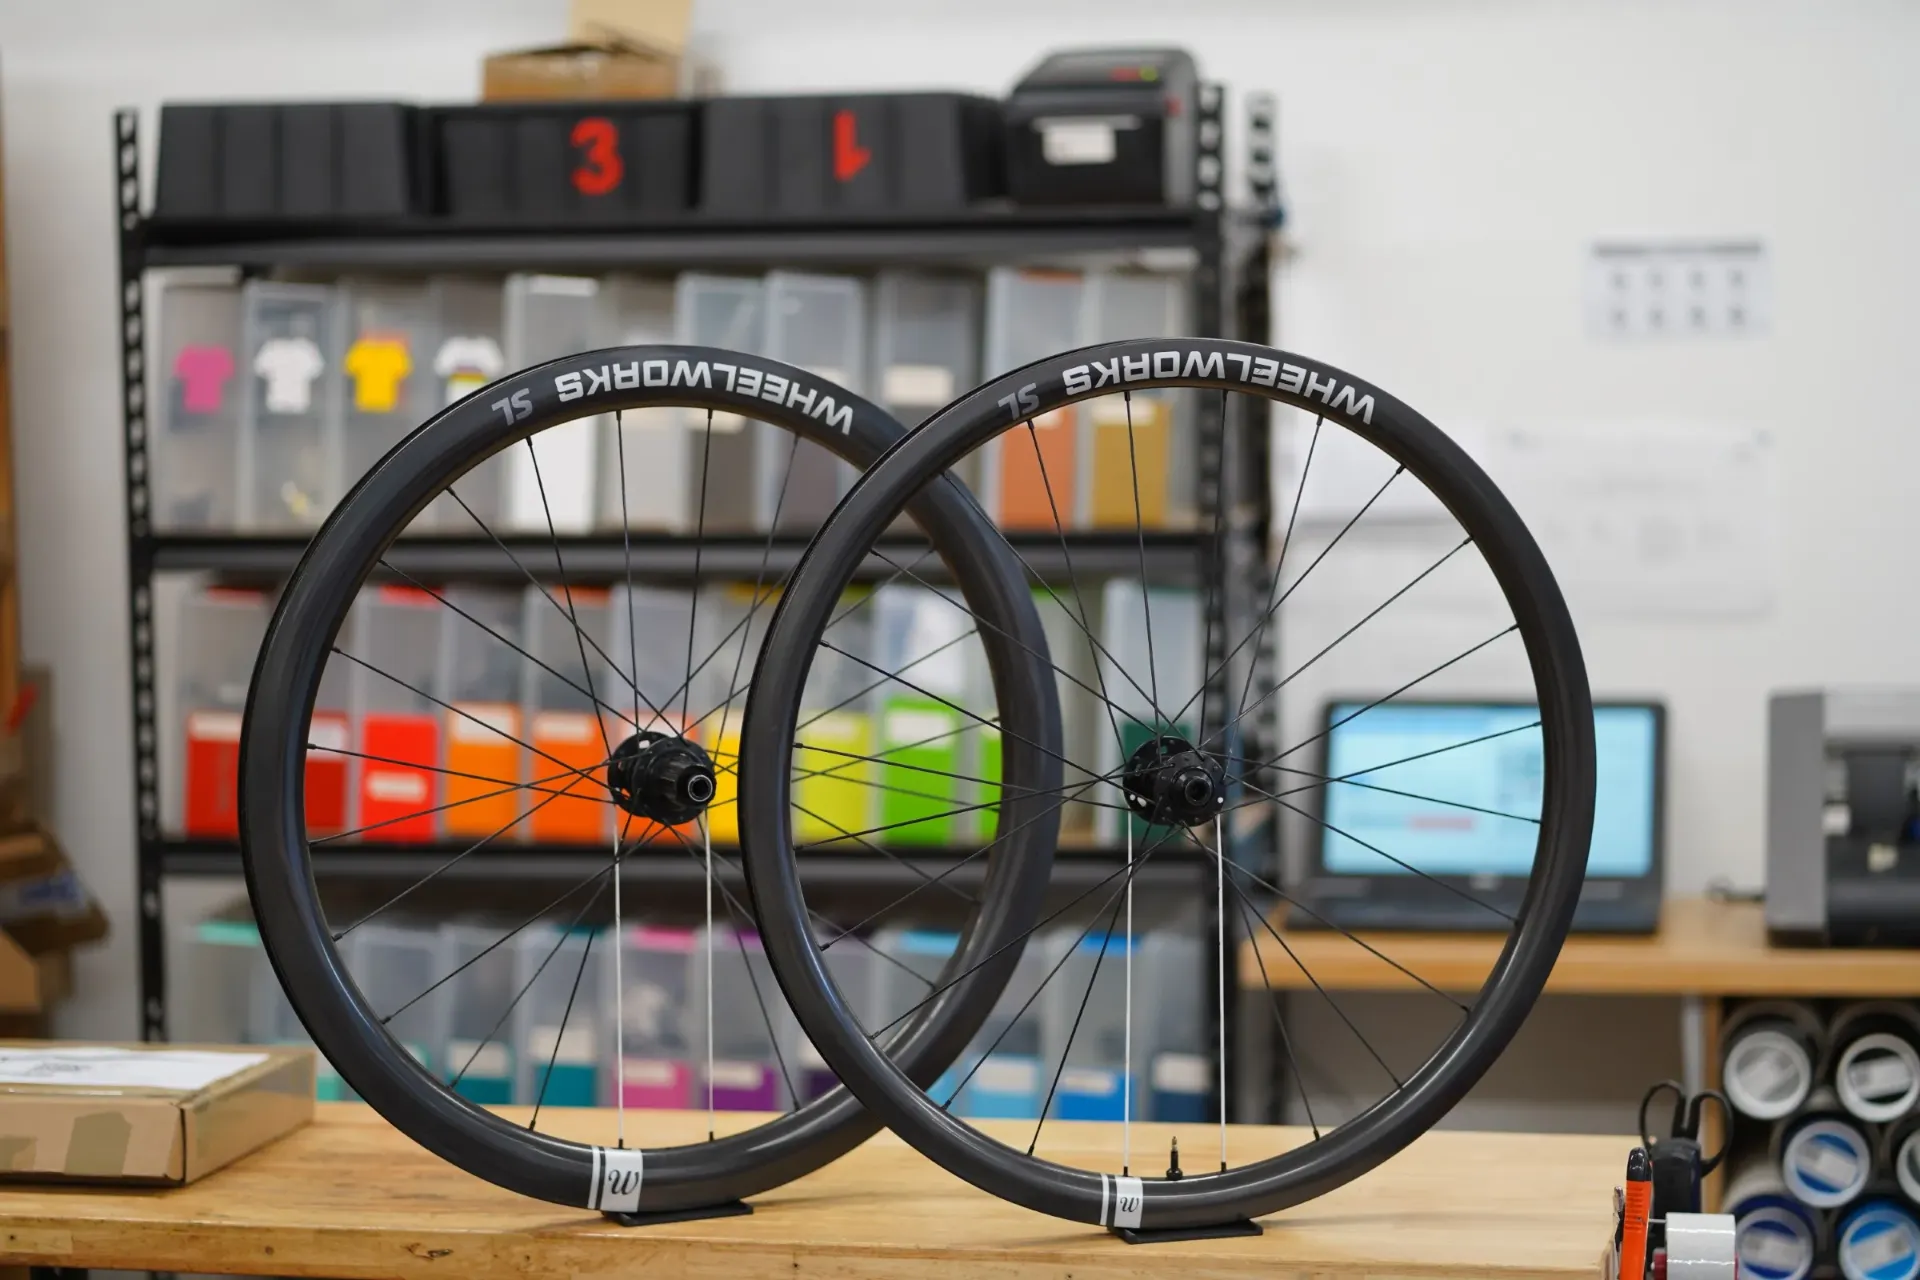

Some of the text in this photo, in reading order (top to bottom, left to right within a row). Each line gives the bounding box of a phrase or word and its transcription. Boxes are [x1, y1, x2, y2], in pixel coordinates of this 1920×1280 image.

[571, 117, 624, 196] 3
[833, 109, 871, 181] 1
[491, 359, 854, 435] WHEELWORKS SL
[998, 350, 1375, 425] WHEELWORKS SL
